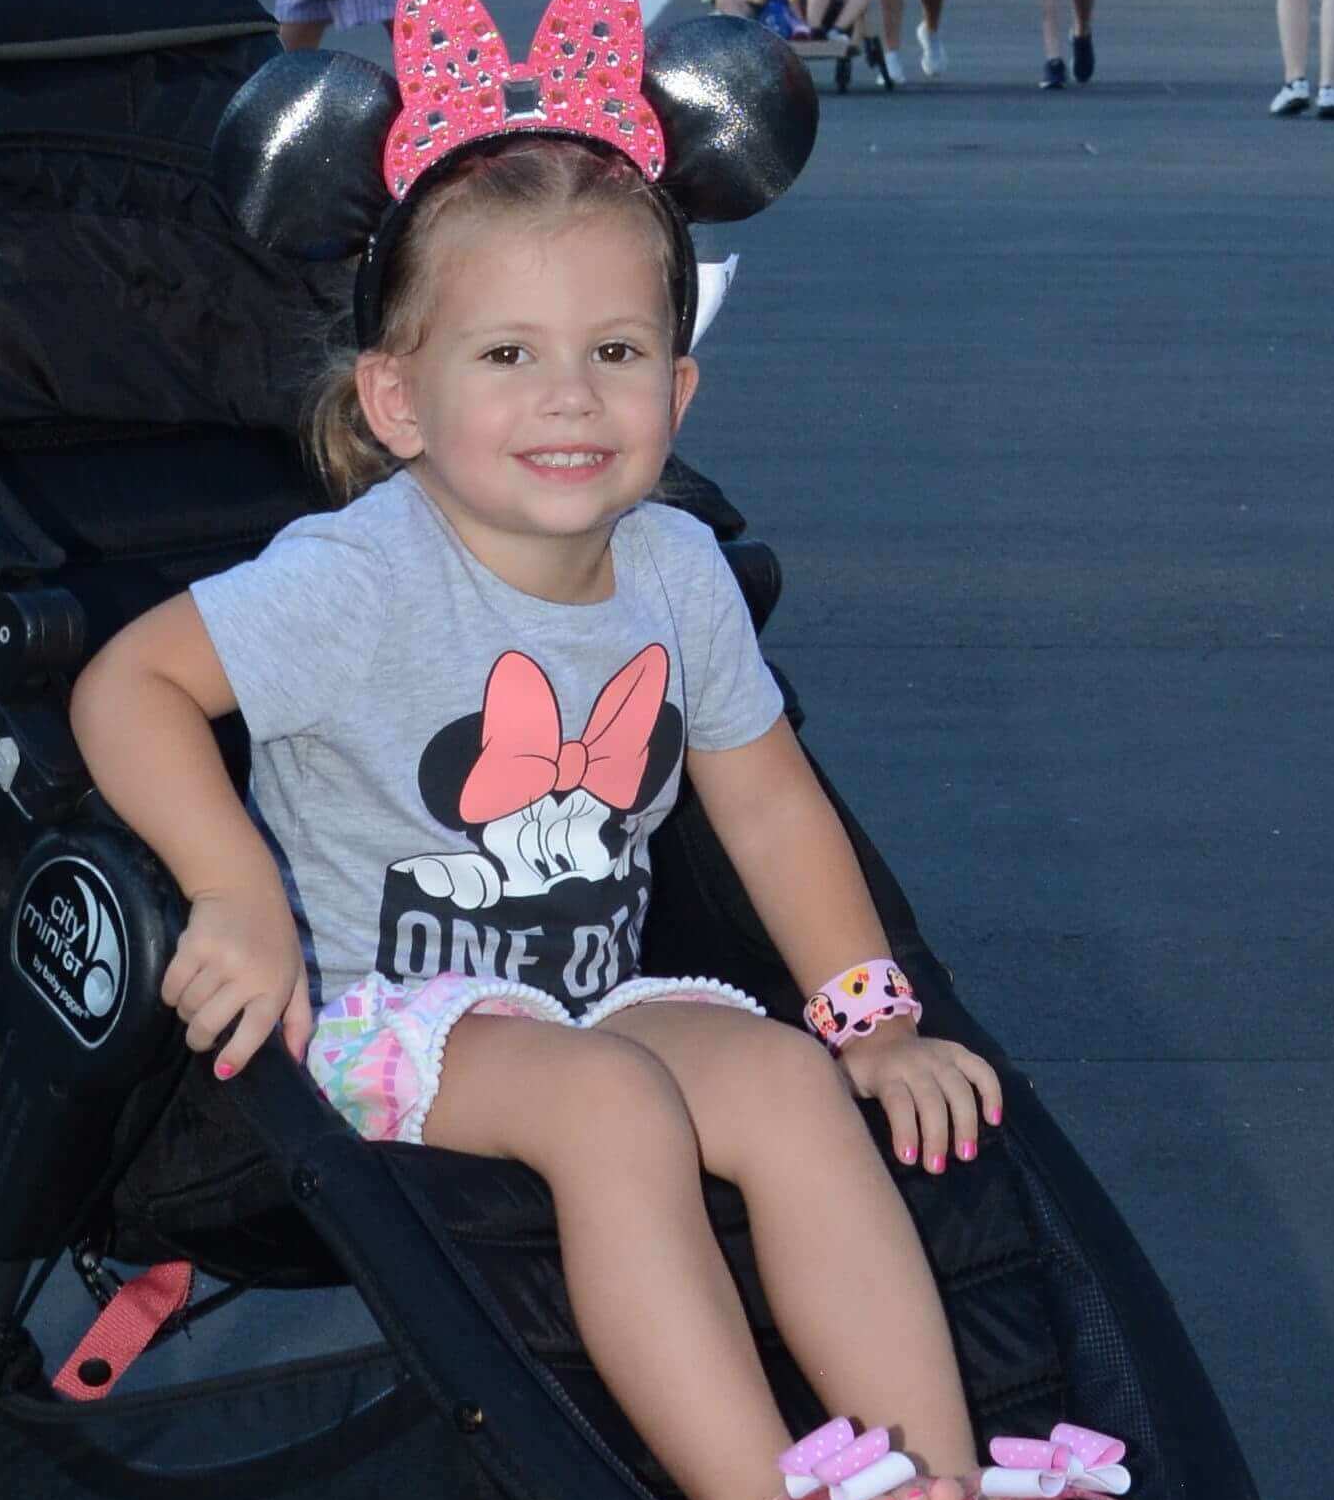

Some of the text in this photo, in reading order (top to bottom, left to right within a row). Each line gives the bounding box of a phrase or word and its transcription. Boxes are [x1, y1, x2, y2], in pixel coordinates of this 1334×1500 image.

[22, 901, 84, 979] mini GT
[50, 895, 86, 944] city
